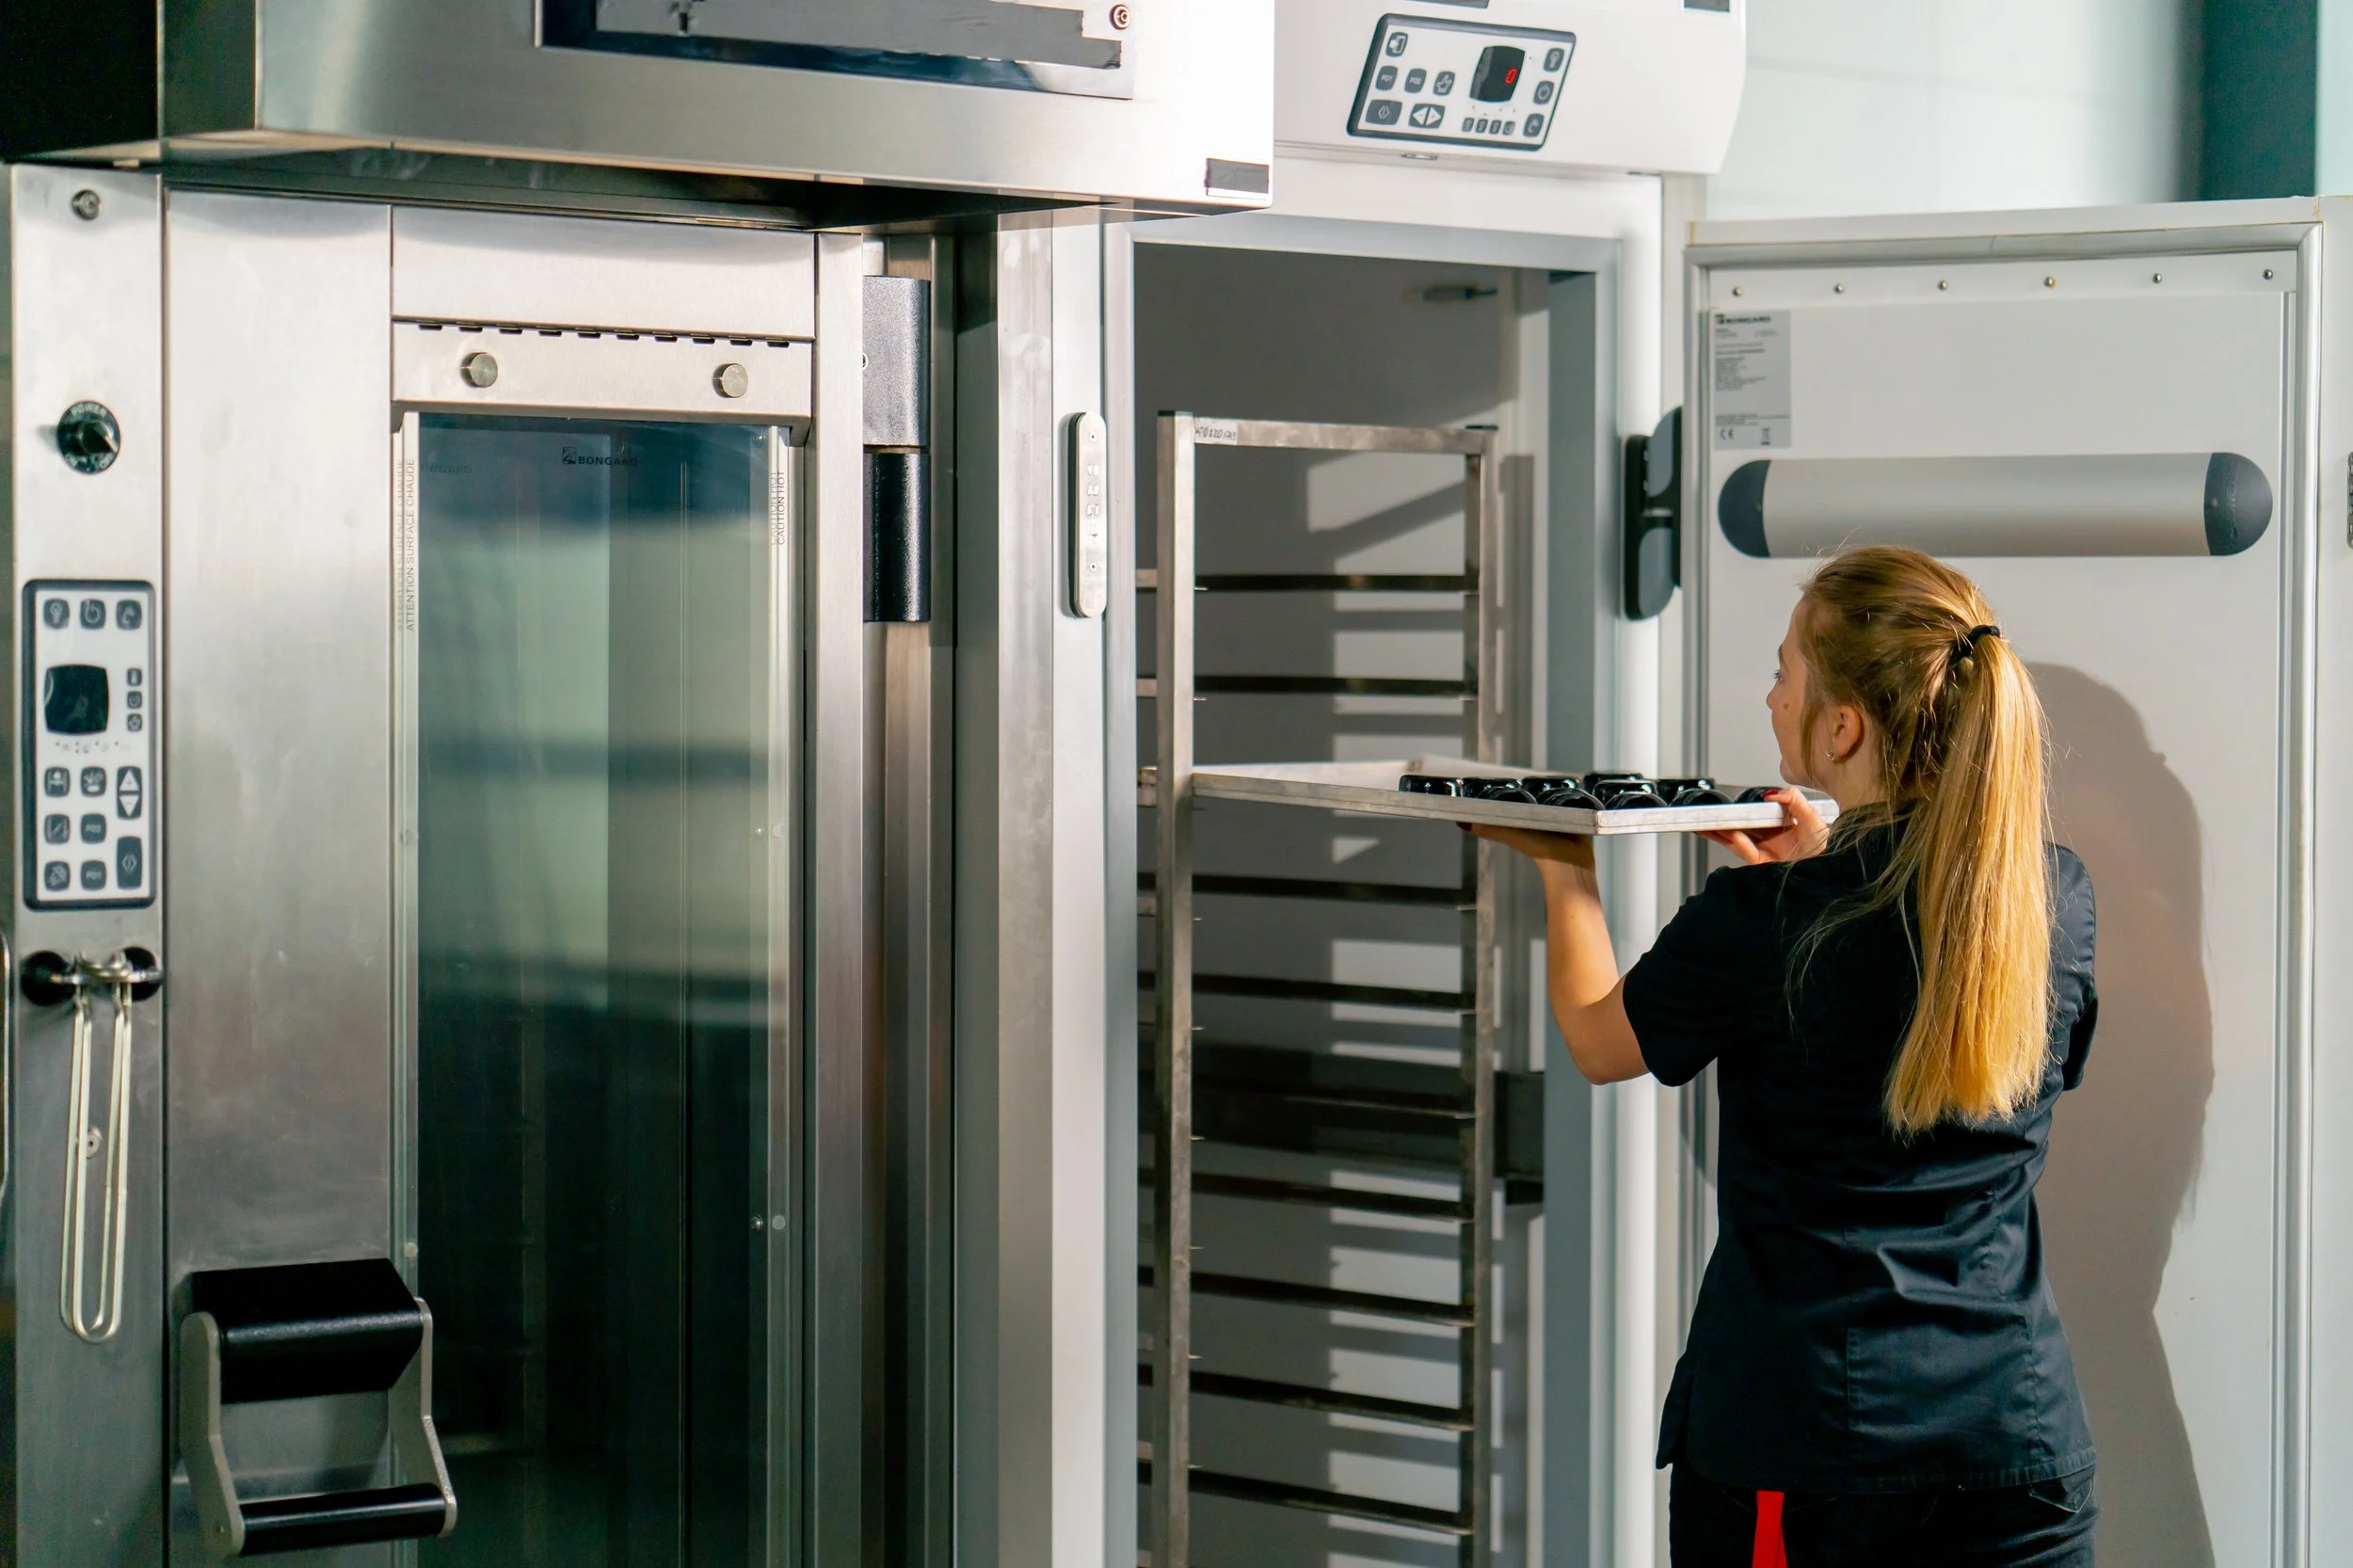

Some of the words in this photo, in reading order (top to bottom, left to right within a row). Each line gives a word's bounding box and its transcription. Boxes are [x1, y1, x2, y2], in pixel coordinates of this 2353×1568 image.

[407, 458, 415, 506] CHAUDE
[776, 470, 786, 493] HOT
[407, 510, 415, 564] SURFACE
[776, 496, 786, 546] CAUTION
[406, 567, 415, 632] ATTENTION
